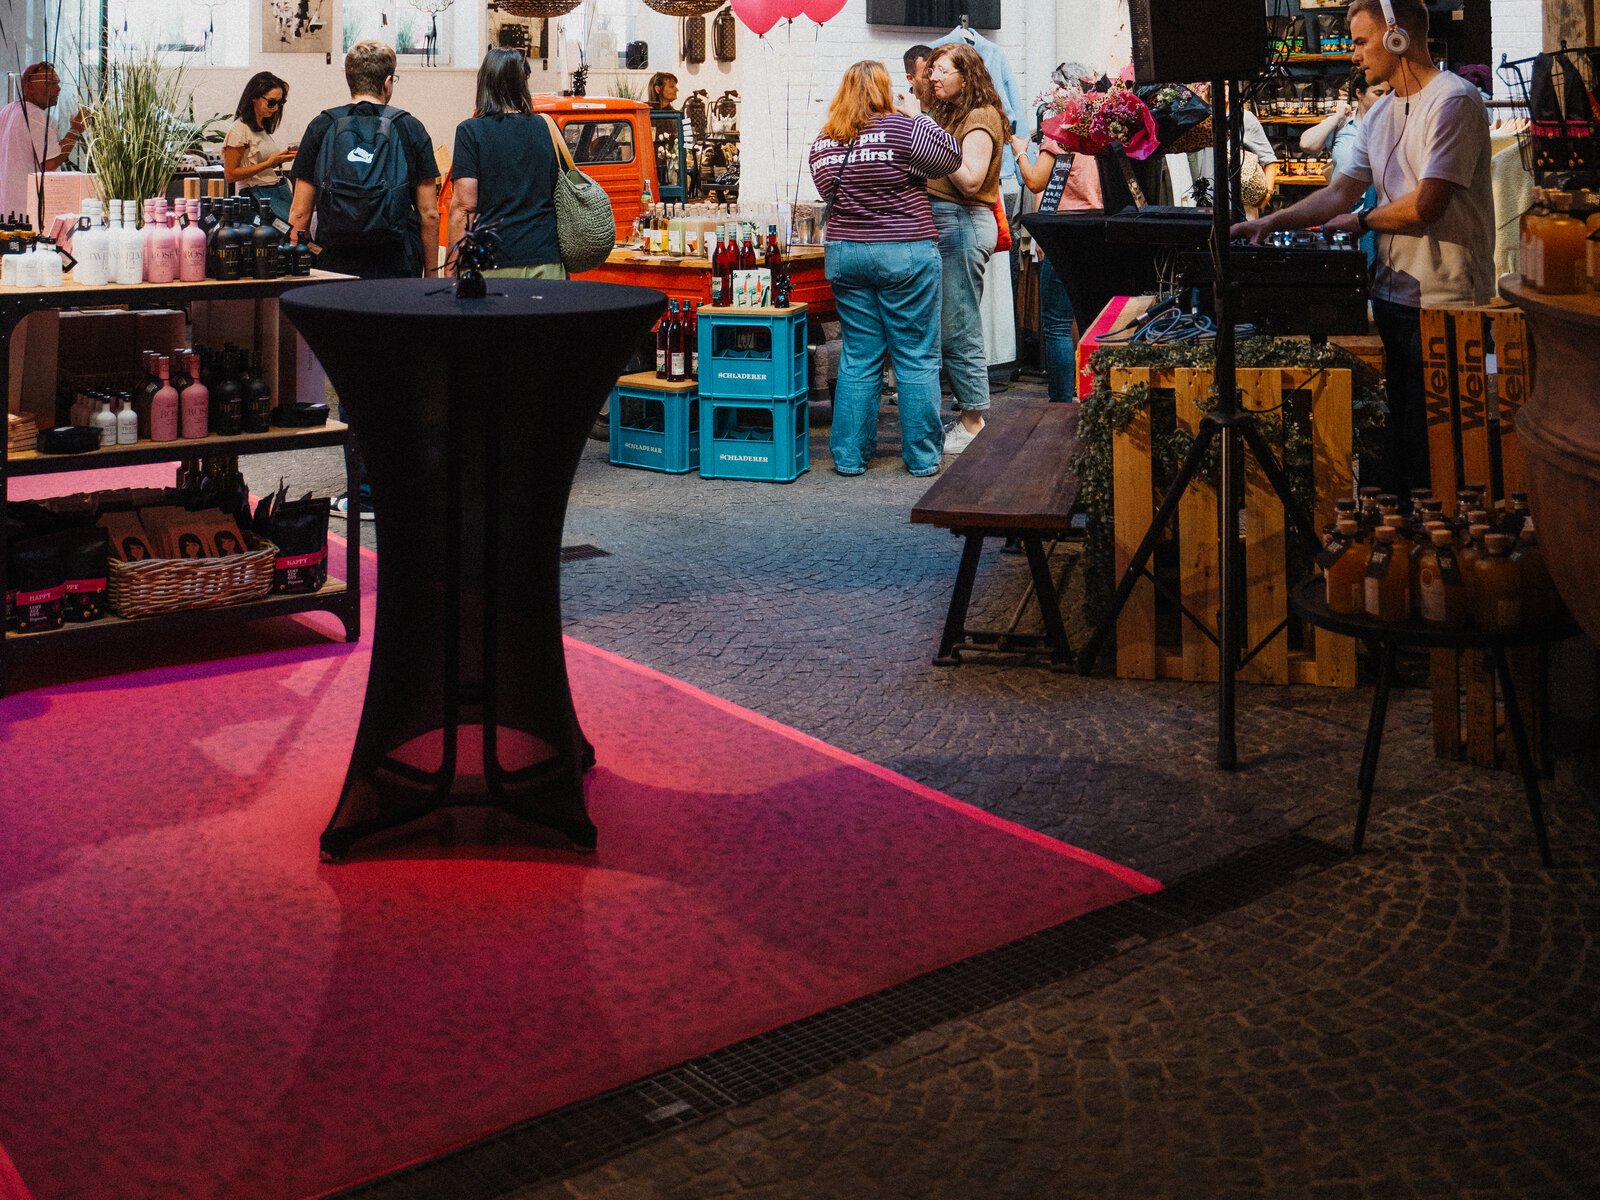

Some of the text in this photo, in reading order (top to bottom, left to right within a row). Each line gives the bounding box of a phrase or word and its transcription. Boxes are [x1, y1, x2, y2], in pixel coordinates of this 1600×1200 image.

[860, 131, 886, 147] put
[811, 149, 894, 176] yourself first
[718, 372, 767, 380] SCHLADERER
[1424, 336, 1451, 427] Wein
[1459, 340, 1485, 431] Wein
[1497, 341, 1523, 435] Wein
[624, 442, 663, 454] SCHLADERER
[720, 454, 768, 463] SCHLADERER
[287, 558, 309, 566] HAPPY
[29, 592, 52, 601] HAPPY
